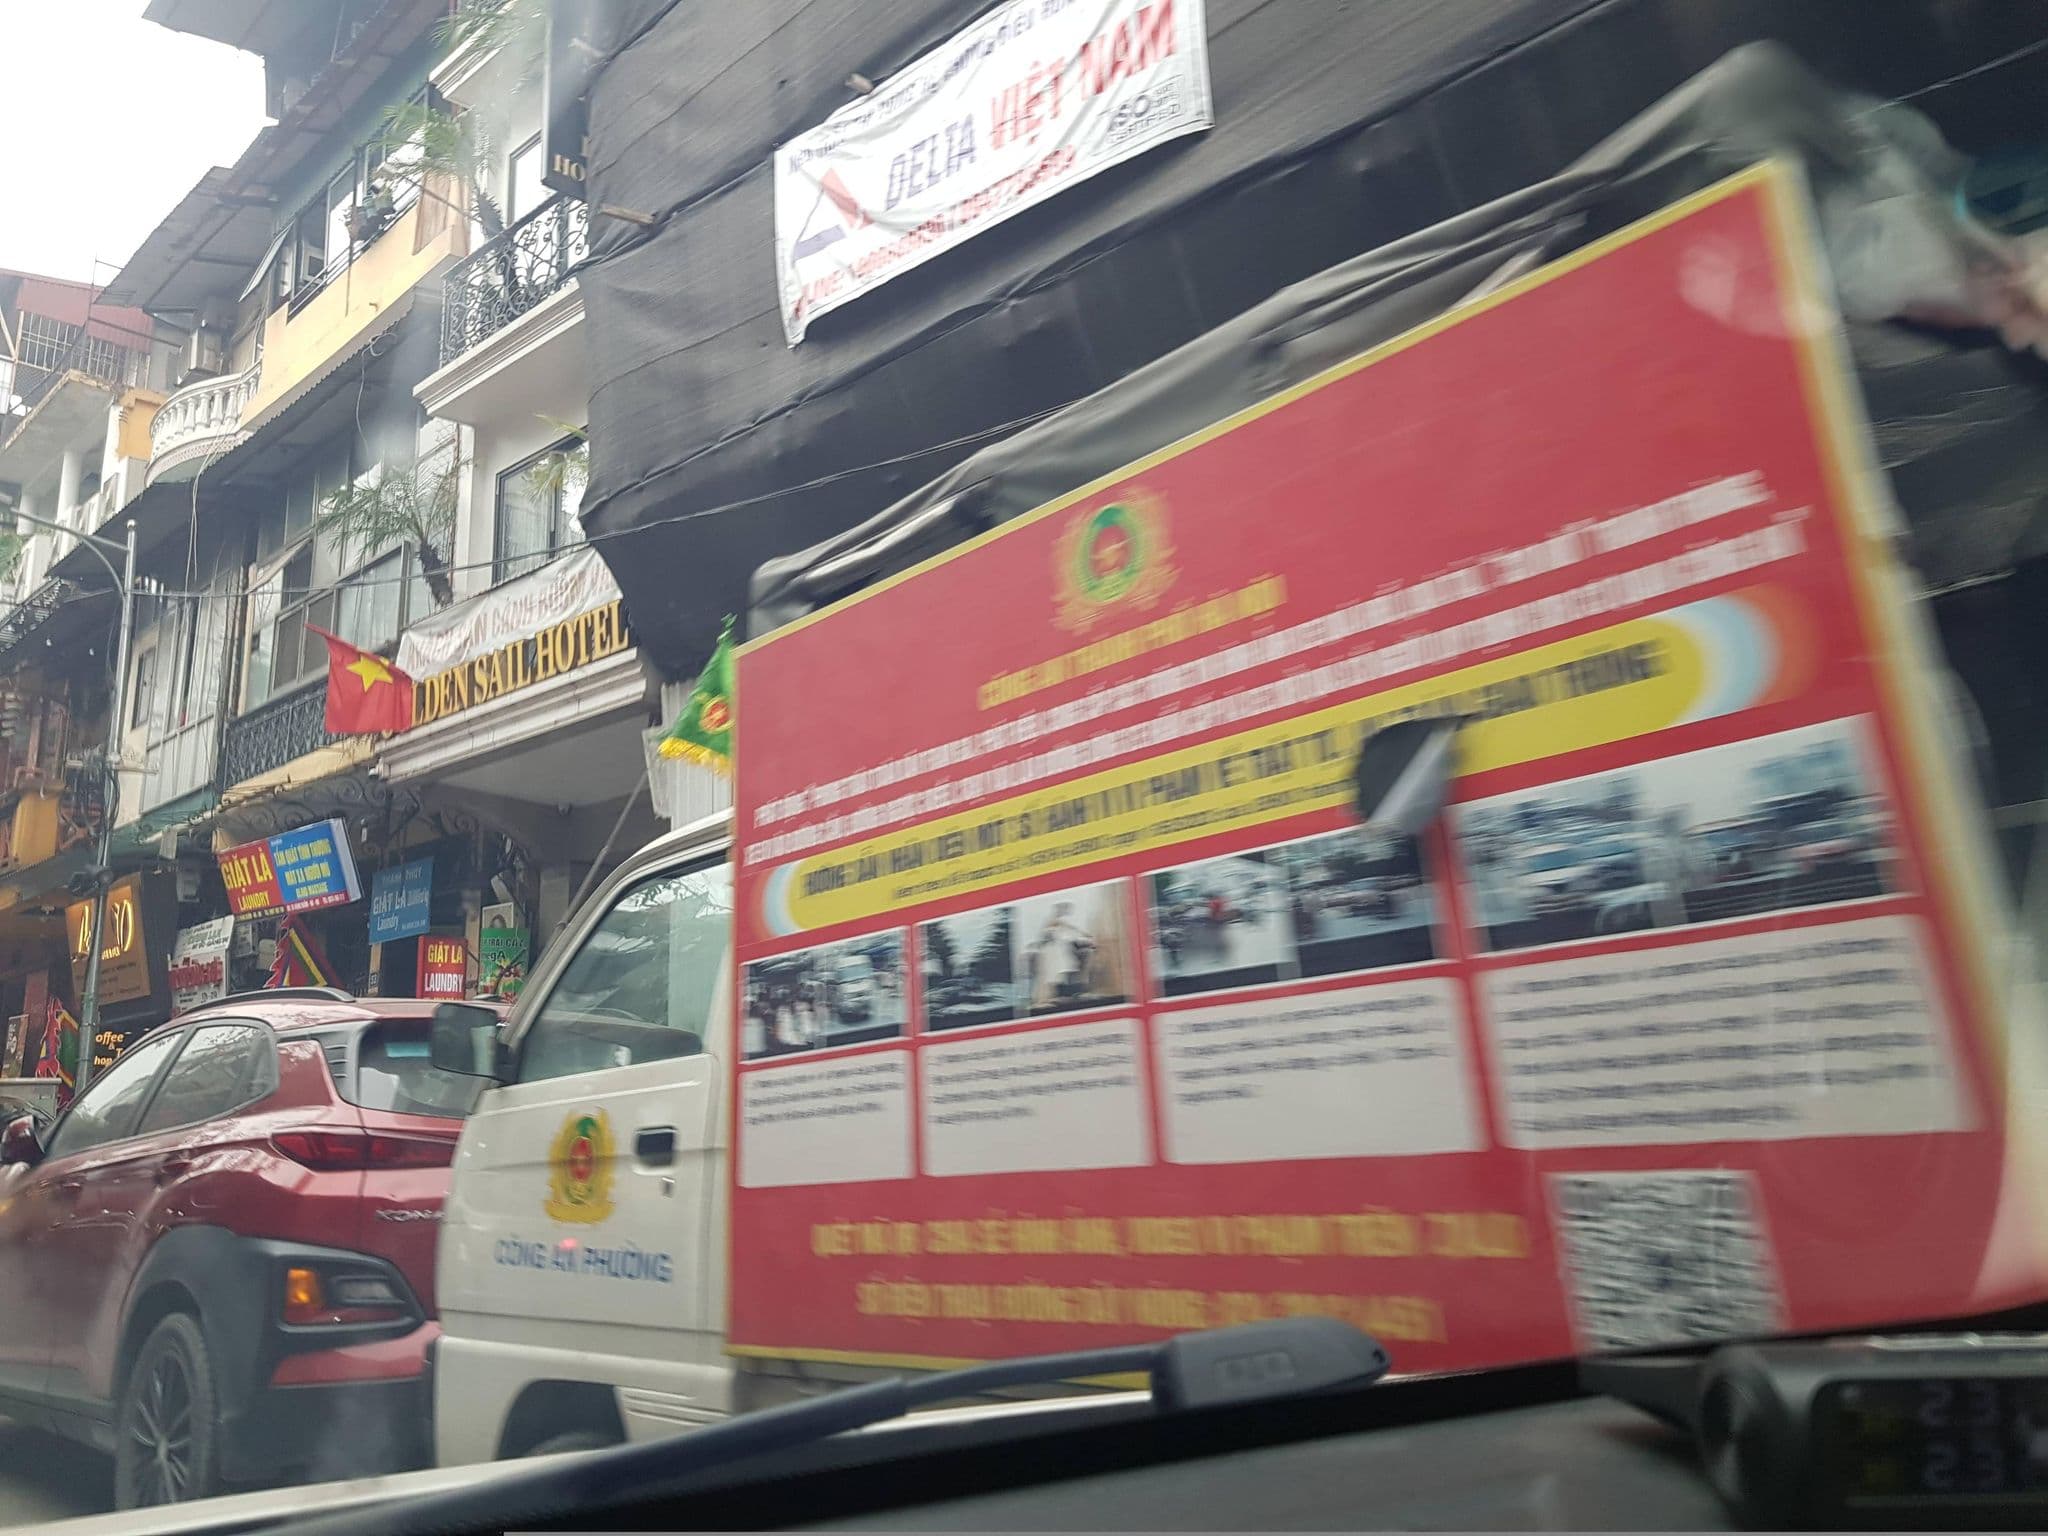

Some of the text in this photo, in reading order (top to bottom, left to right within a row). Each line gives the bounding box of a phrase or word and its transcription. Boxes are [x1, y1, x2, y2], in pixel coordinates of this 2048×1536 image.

[886, 112, 977, 211] DELTA
[990, 57, 1066, 150] VIỆT
[1077, 0, 1182, 102] NAM
[411, 661, 470, 730] LDEN
[474, 638, 532, 705] SAIL
[535, 600, 630, 682] HOTEL
[221, 853, 252, 893] GIẶT
[237, 891, 270, 911] LAUNDRY
[377, 912, 400, 932] Laundry
[428, 940, 450, 967] GIẶT
[424, 973, 464, 993] LAUNDRY
[95, 1031, 125, 1045] offee
[94, 1056, 113, 1067] hop
